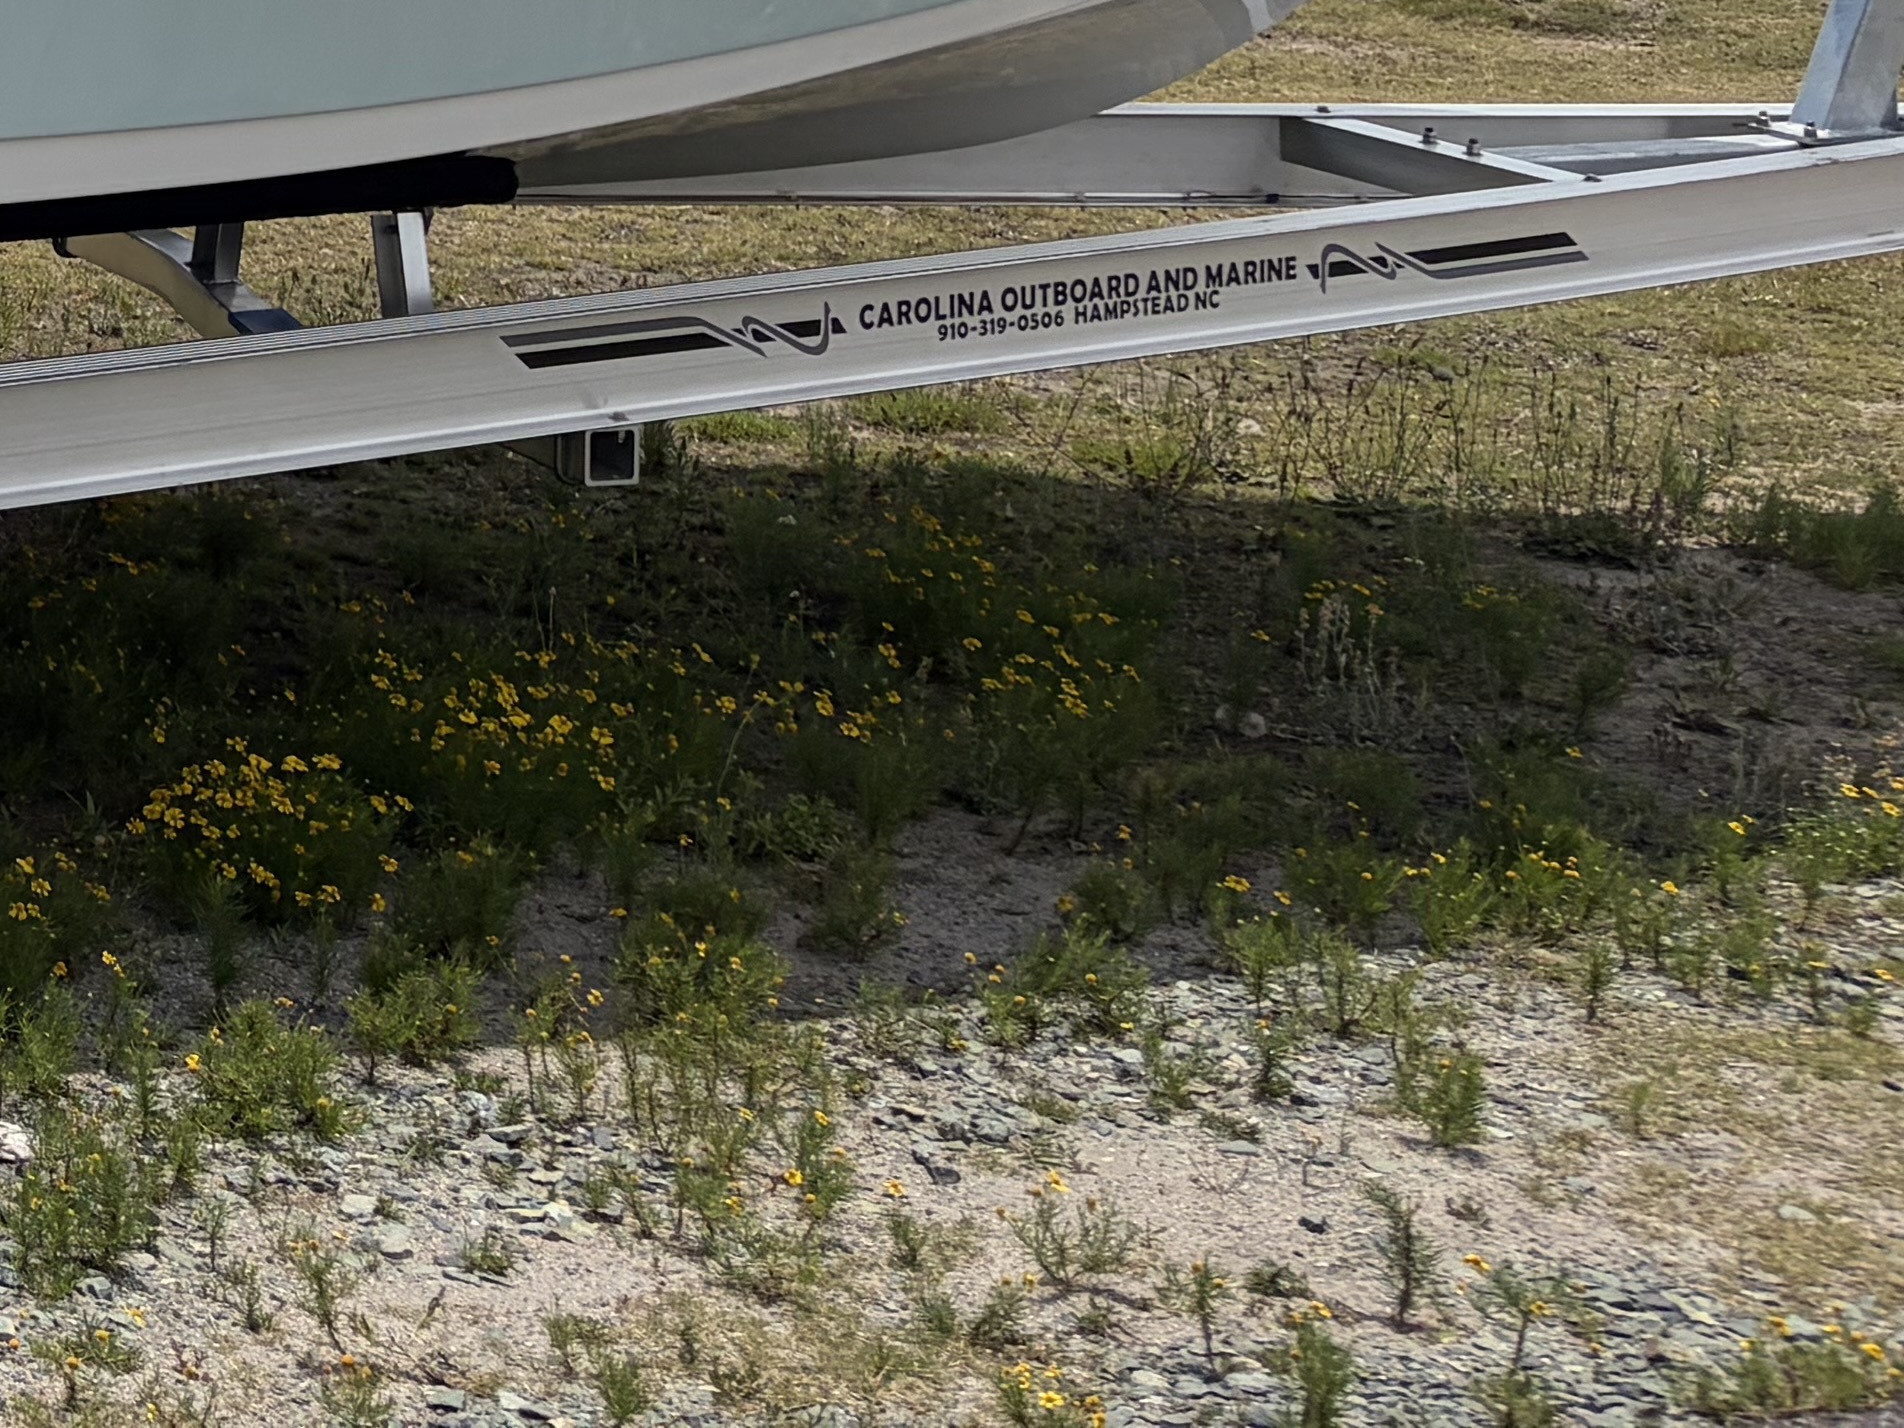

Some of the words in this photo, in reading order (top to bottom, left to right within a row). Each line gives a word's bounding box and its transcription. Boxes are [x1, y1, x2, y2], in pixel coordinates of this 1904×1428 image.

[858, 289, 994, 331] CAROLINA
[1000, 273, 1140, 313] OUTBOARD
[1145, 265, 1198, 296] AND
[1205, 255, 1298, 289] MARINE
[936, 309, 1065, 342] 910-319-0506
[1073, 293, 1190, 325] HAMPSTEAD
[1193, 289, 1221, 311] NC
